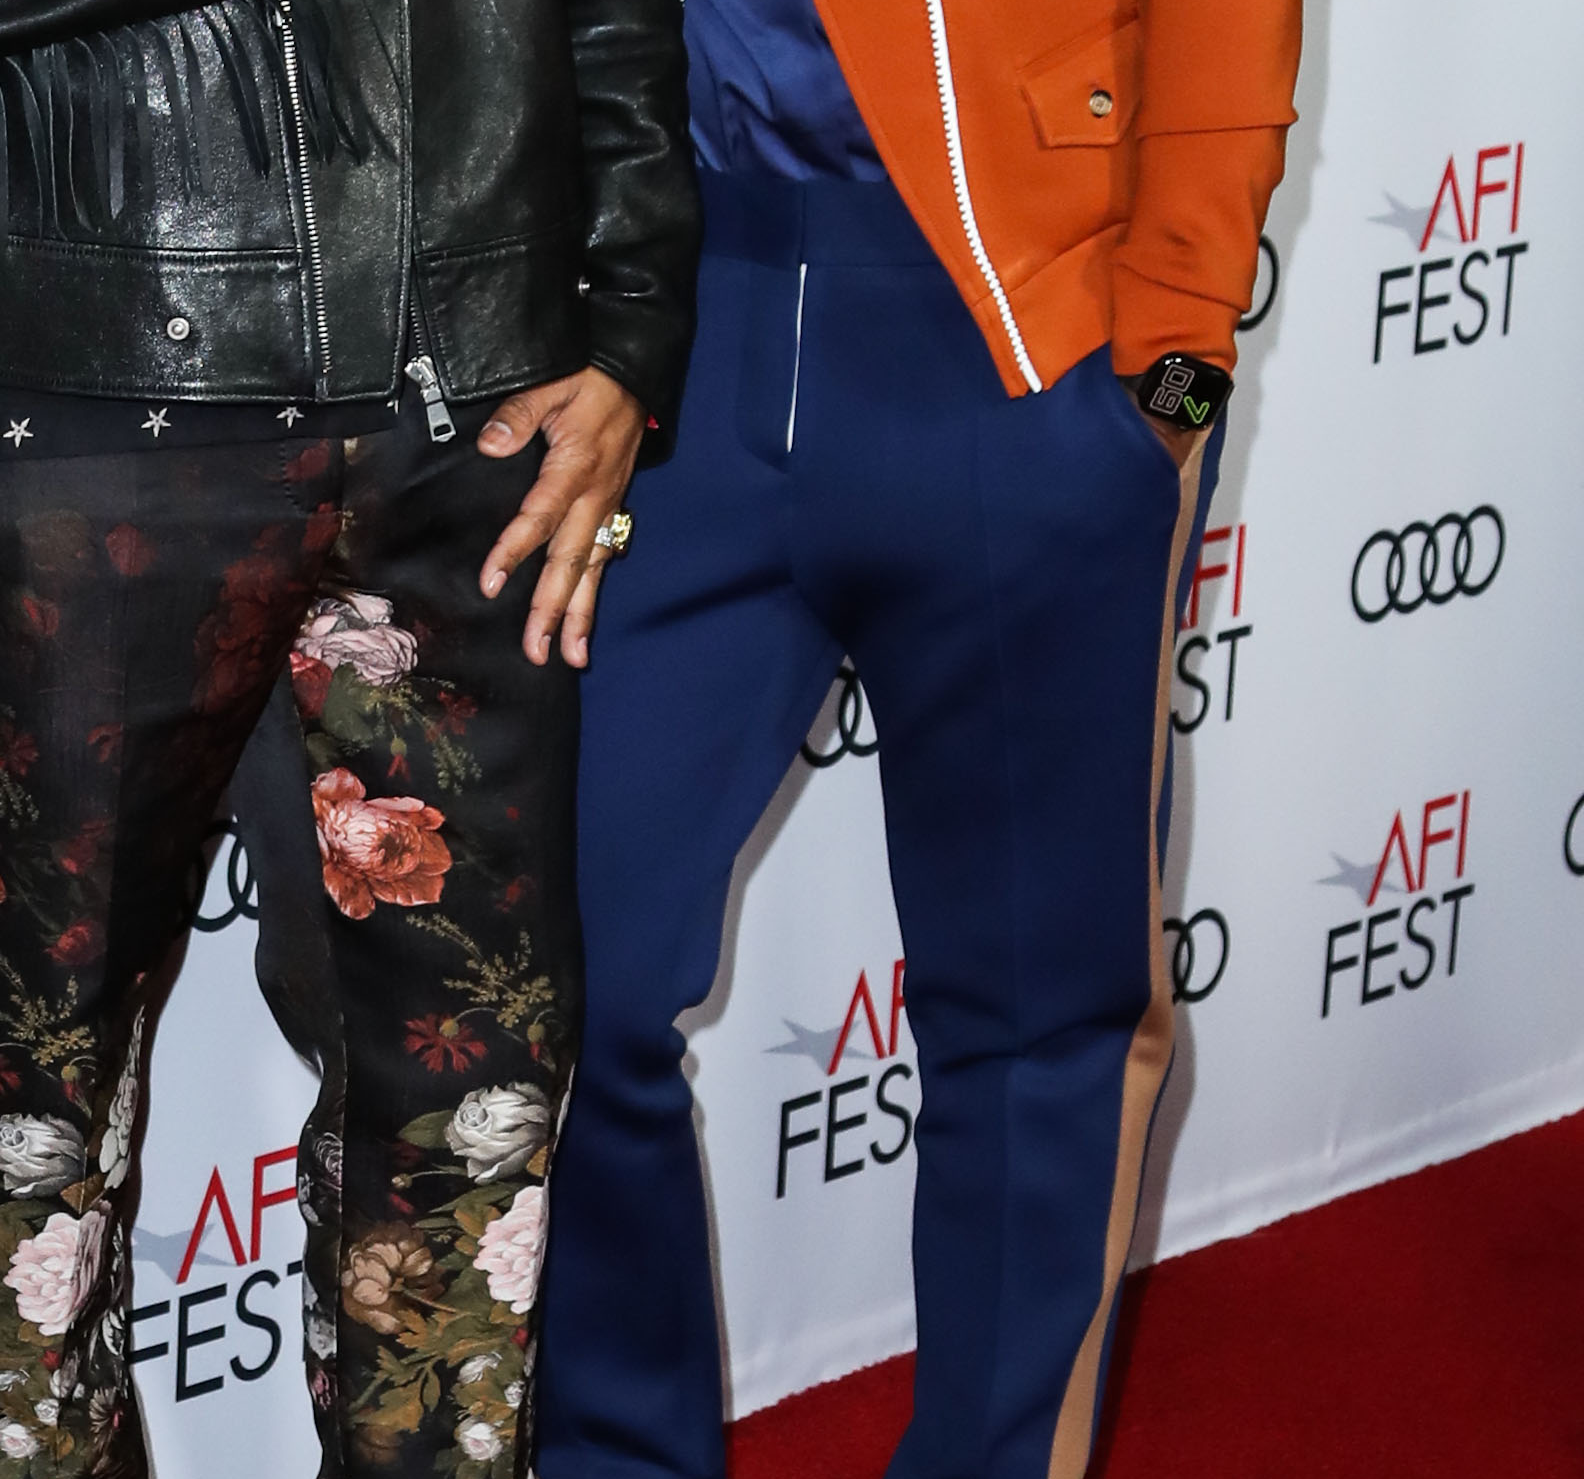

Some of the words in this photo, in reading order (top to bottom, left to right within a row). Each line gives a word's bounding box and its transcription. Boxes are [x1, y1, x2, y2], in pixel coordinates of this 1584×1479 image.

[1419, 141, 1526, 253] AFI
[1372, 241, 1530, 366] FEST
[1180, 524, 1247, 631] FI
[1171, 624, 1253, 736] ST
[1367, 790, 1472, 907] AFI
[1320, 883, 1476, 1020] FEST
[775, 1062, 915, 1201] FES
[176, 1144, 298, 1285] AF
